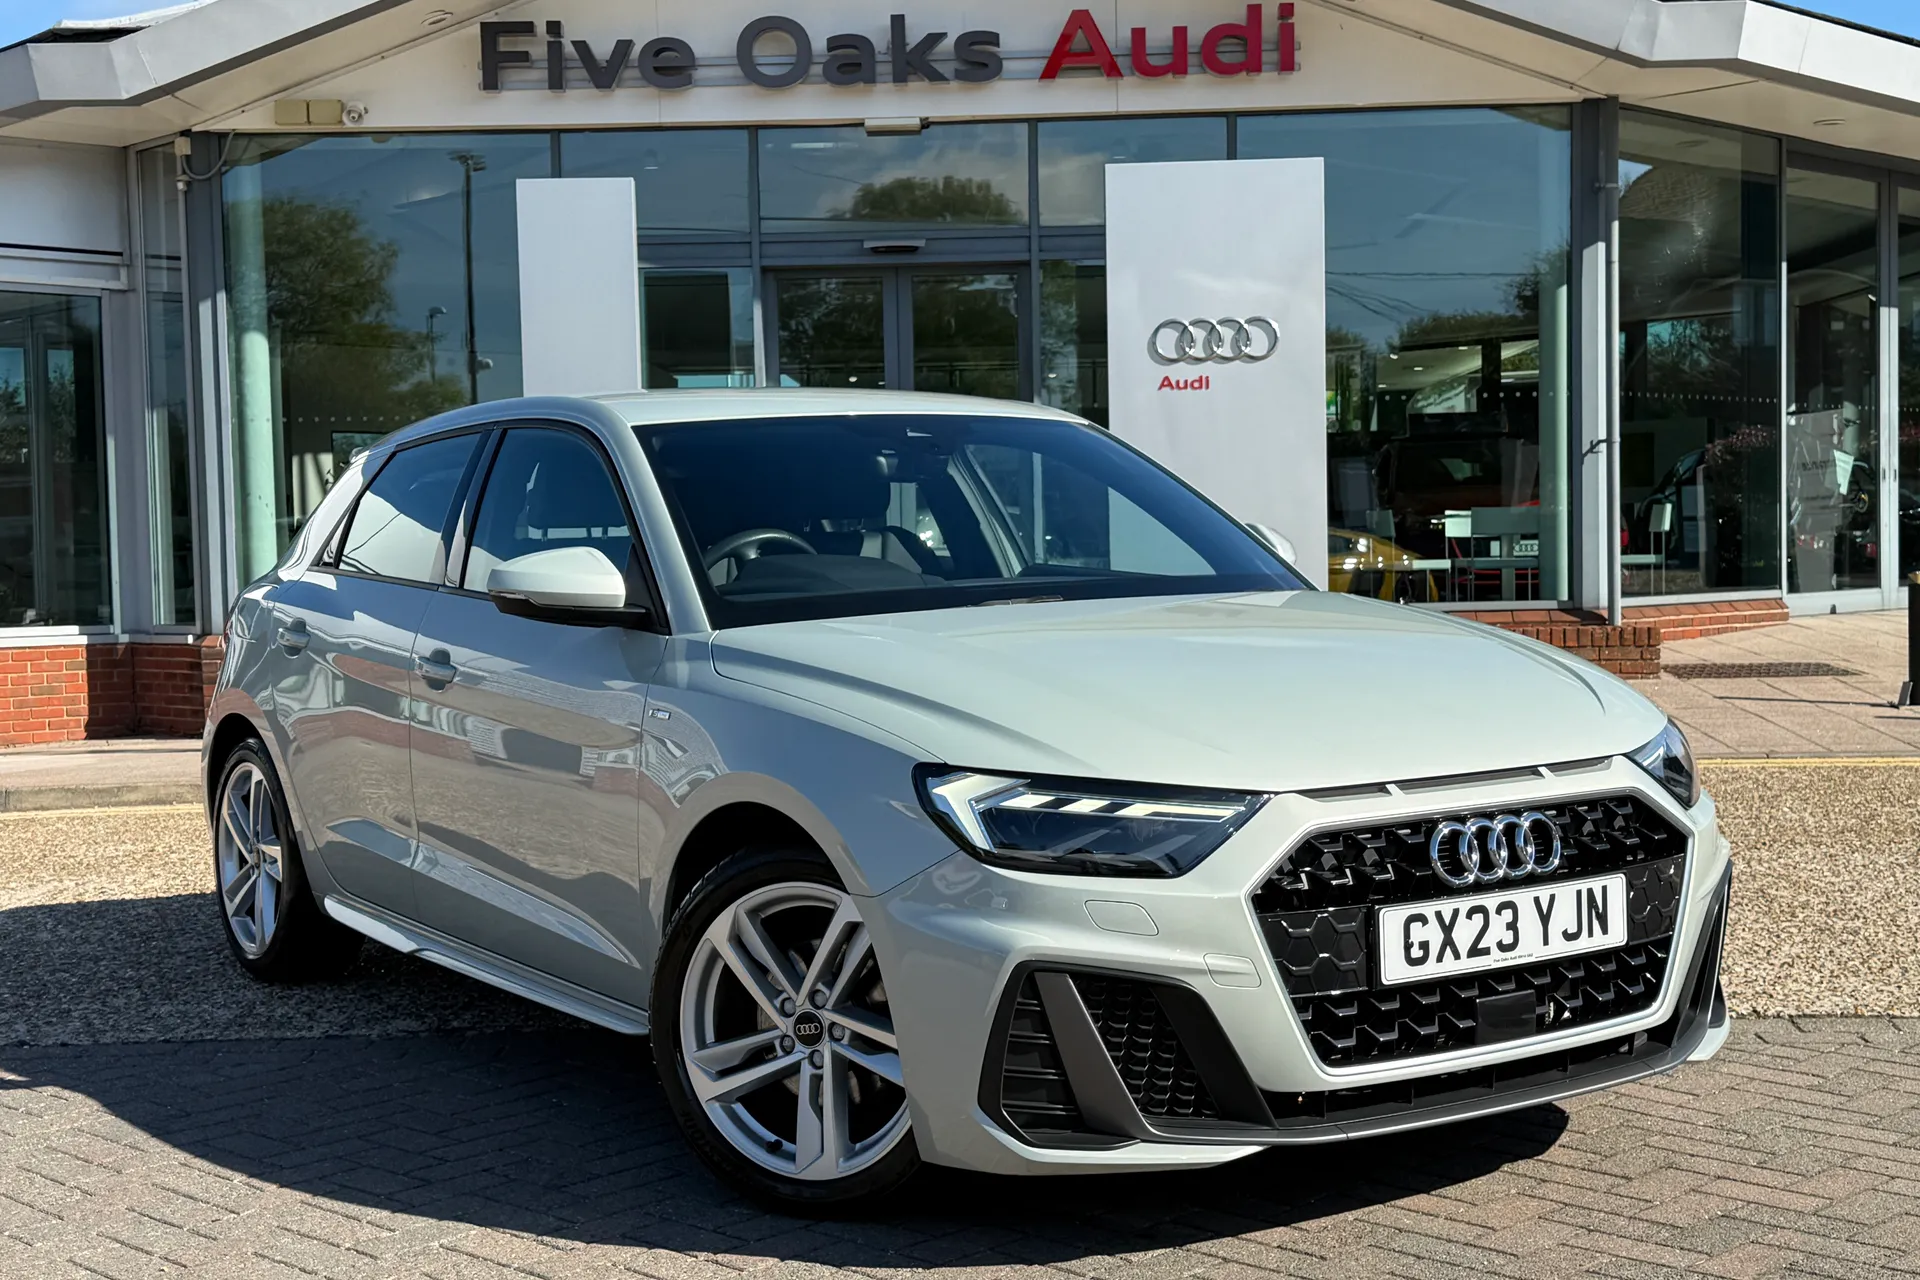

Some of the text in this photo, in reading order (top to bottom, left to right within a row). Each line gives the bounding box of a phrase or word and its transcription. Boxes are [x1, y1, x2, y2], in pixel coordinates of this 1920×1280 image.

[479, 2, 1296, 91] Five Oaks Audi
[1157, 375, 1210, 391] Audi
[1403, 885, 1609, 967] GX23 YJN
